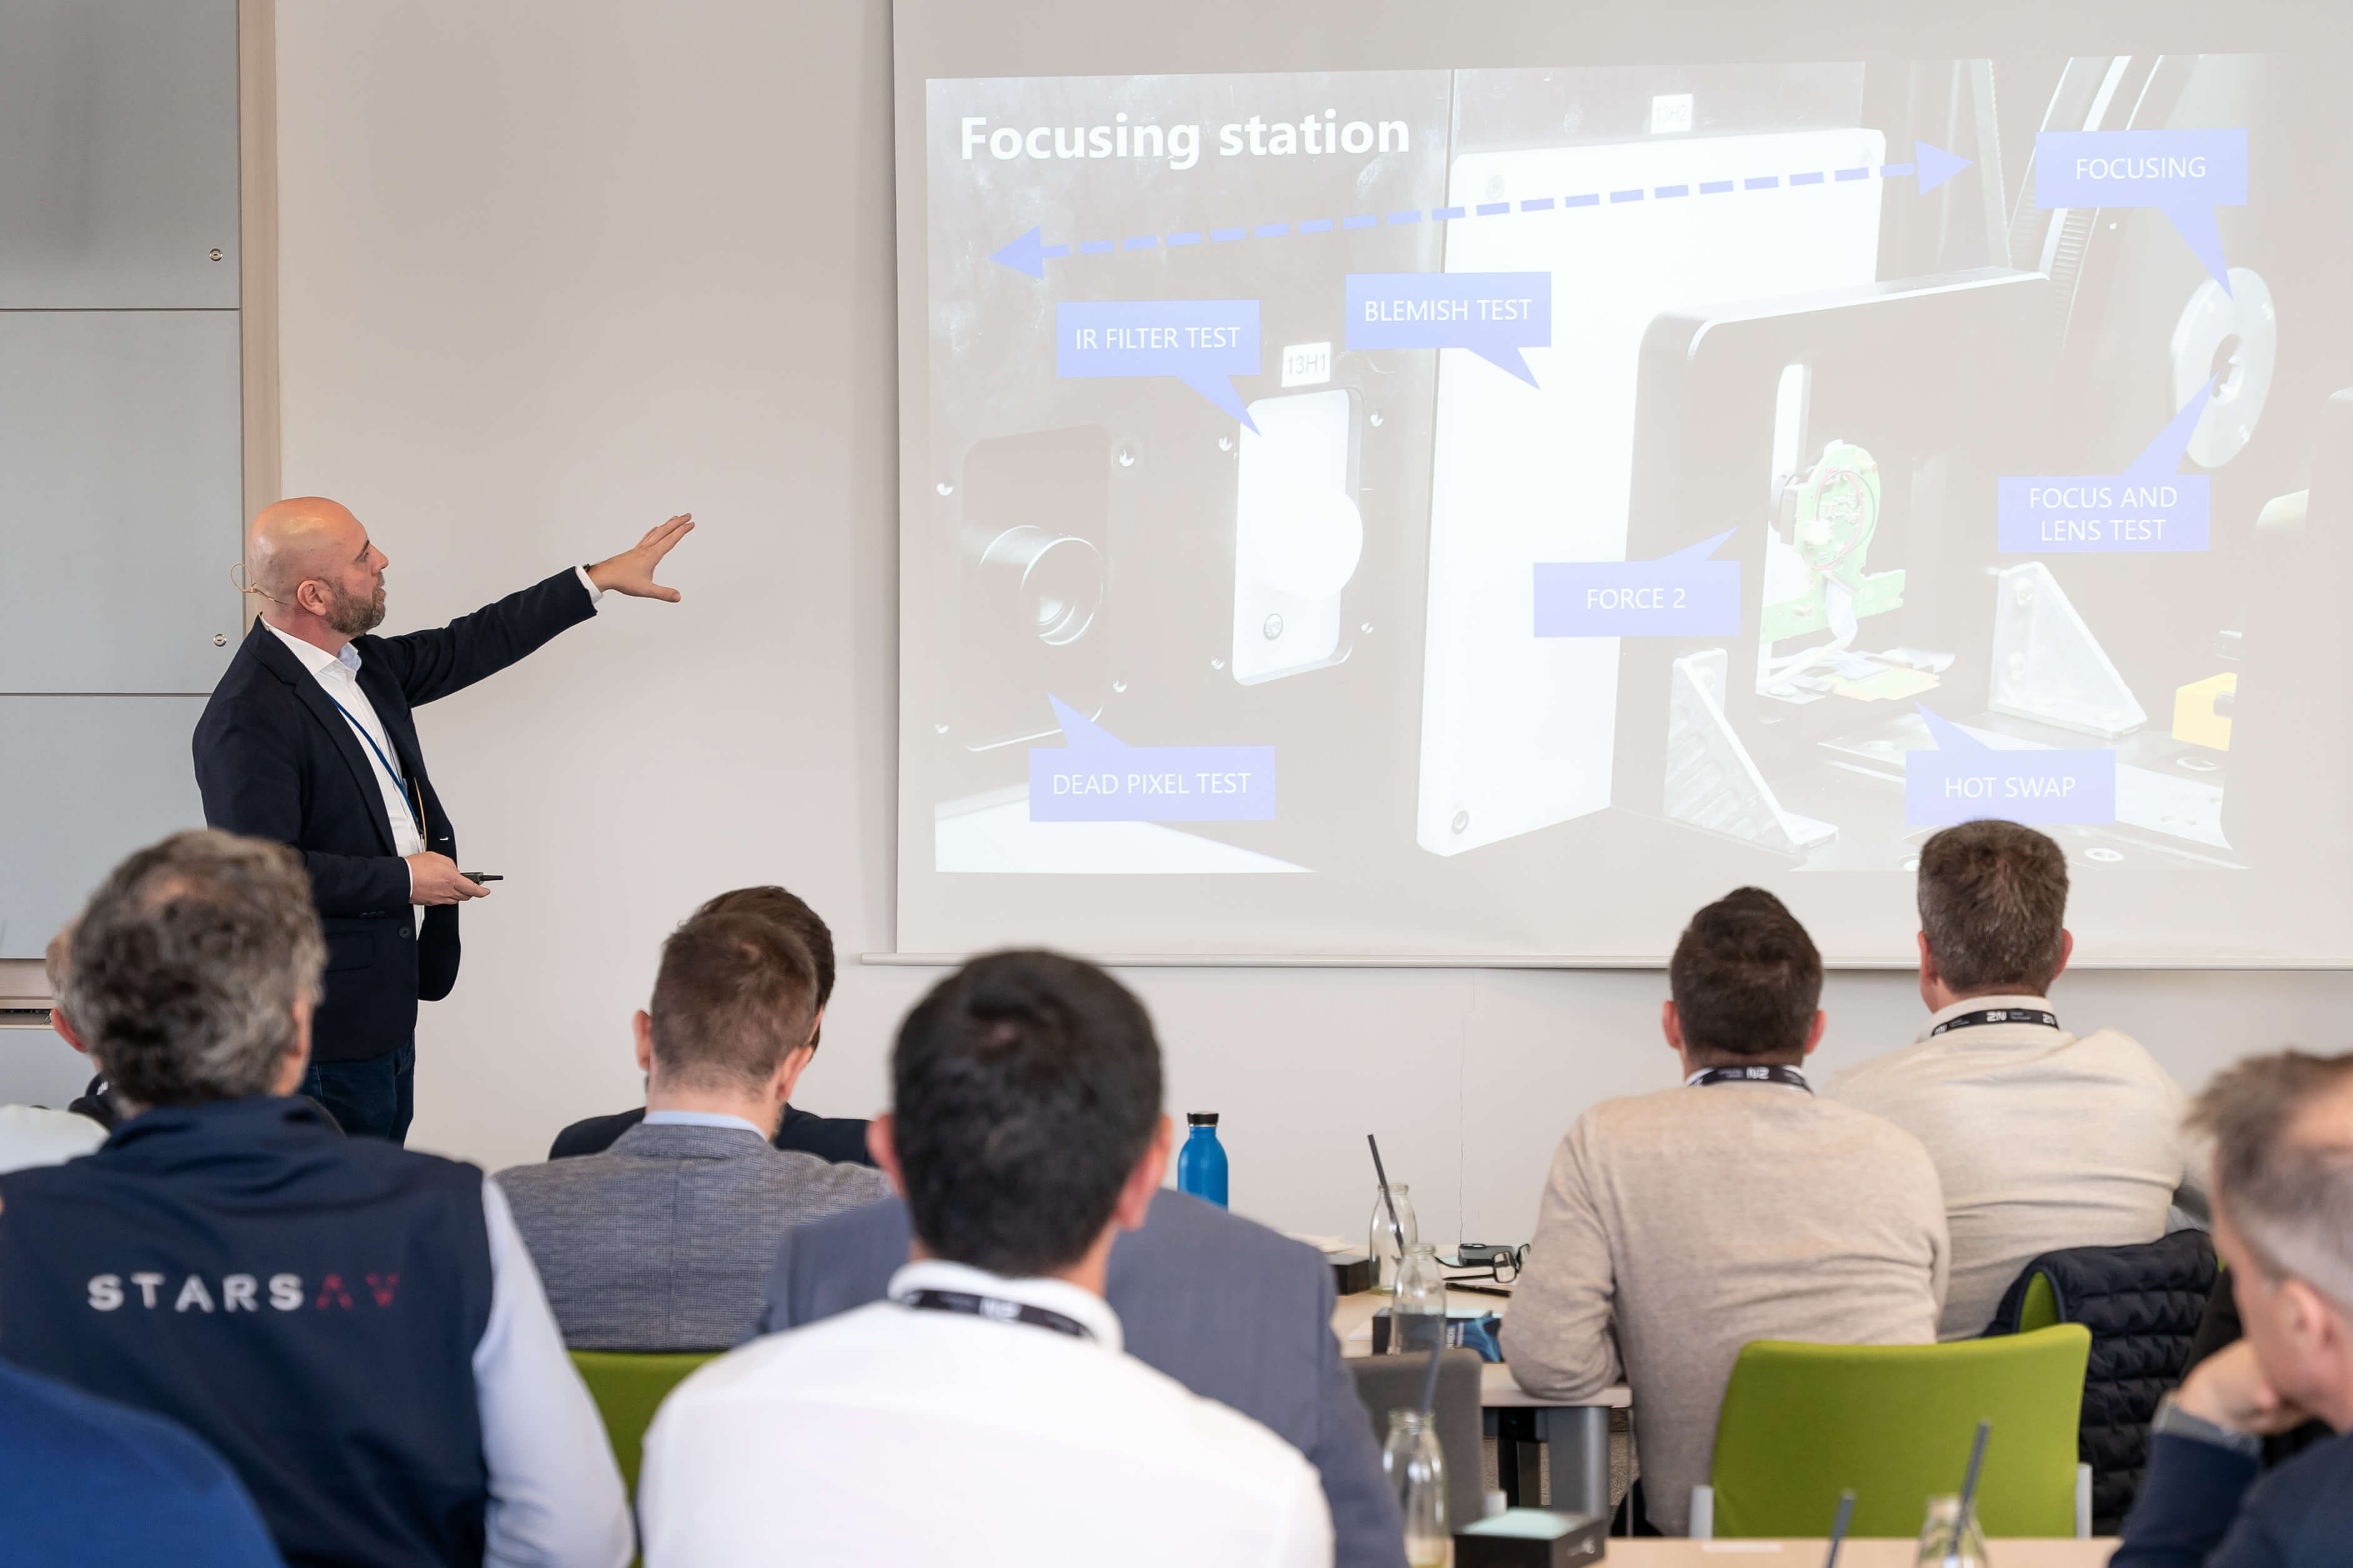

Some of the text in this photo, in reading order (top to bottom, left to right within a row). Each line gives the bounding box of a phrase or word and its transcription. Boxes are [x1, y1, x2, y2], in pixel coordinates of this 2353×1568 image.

[960, 107, 1410, 171] Focusing station
[2075, 156, 2207, 181] FOCUSING
[1365, 298, 1533, 322] BLEMISH TEST
[1076, 326, 1242, 350] IR FILTER TEST
[1287, 353, 1326, 375] 13H1
[2029, 486, 2178, 509] FOCUS AND
[2041, 519, 2167, 542] LENS TEST
[1587, 587, 1687, 610] FORCE 2
[1053, 772, 1252, 795] DEAD PIXEL TEST
[1945, 776, 2077, 799] HOT SWAP
